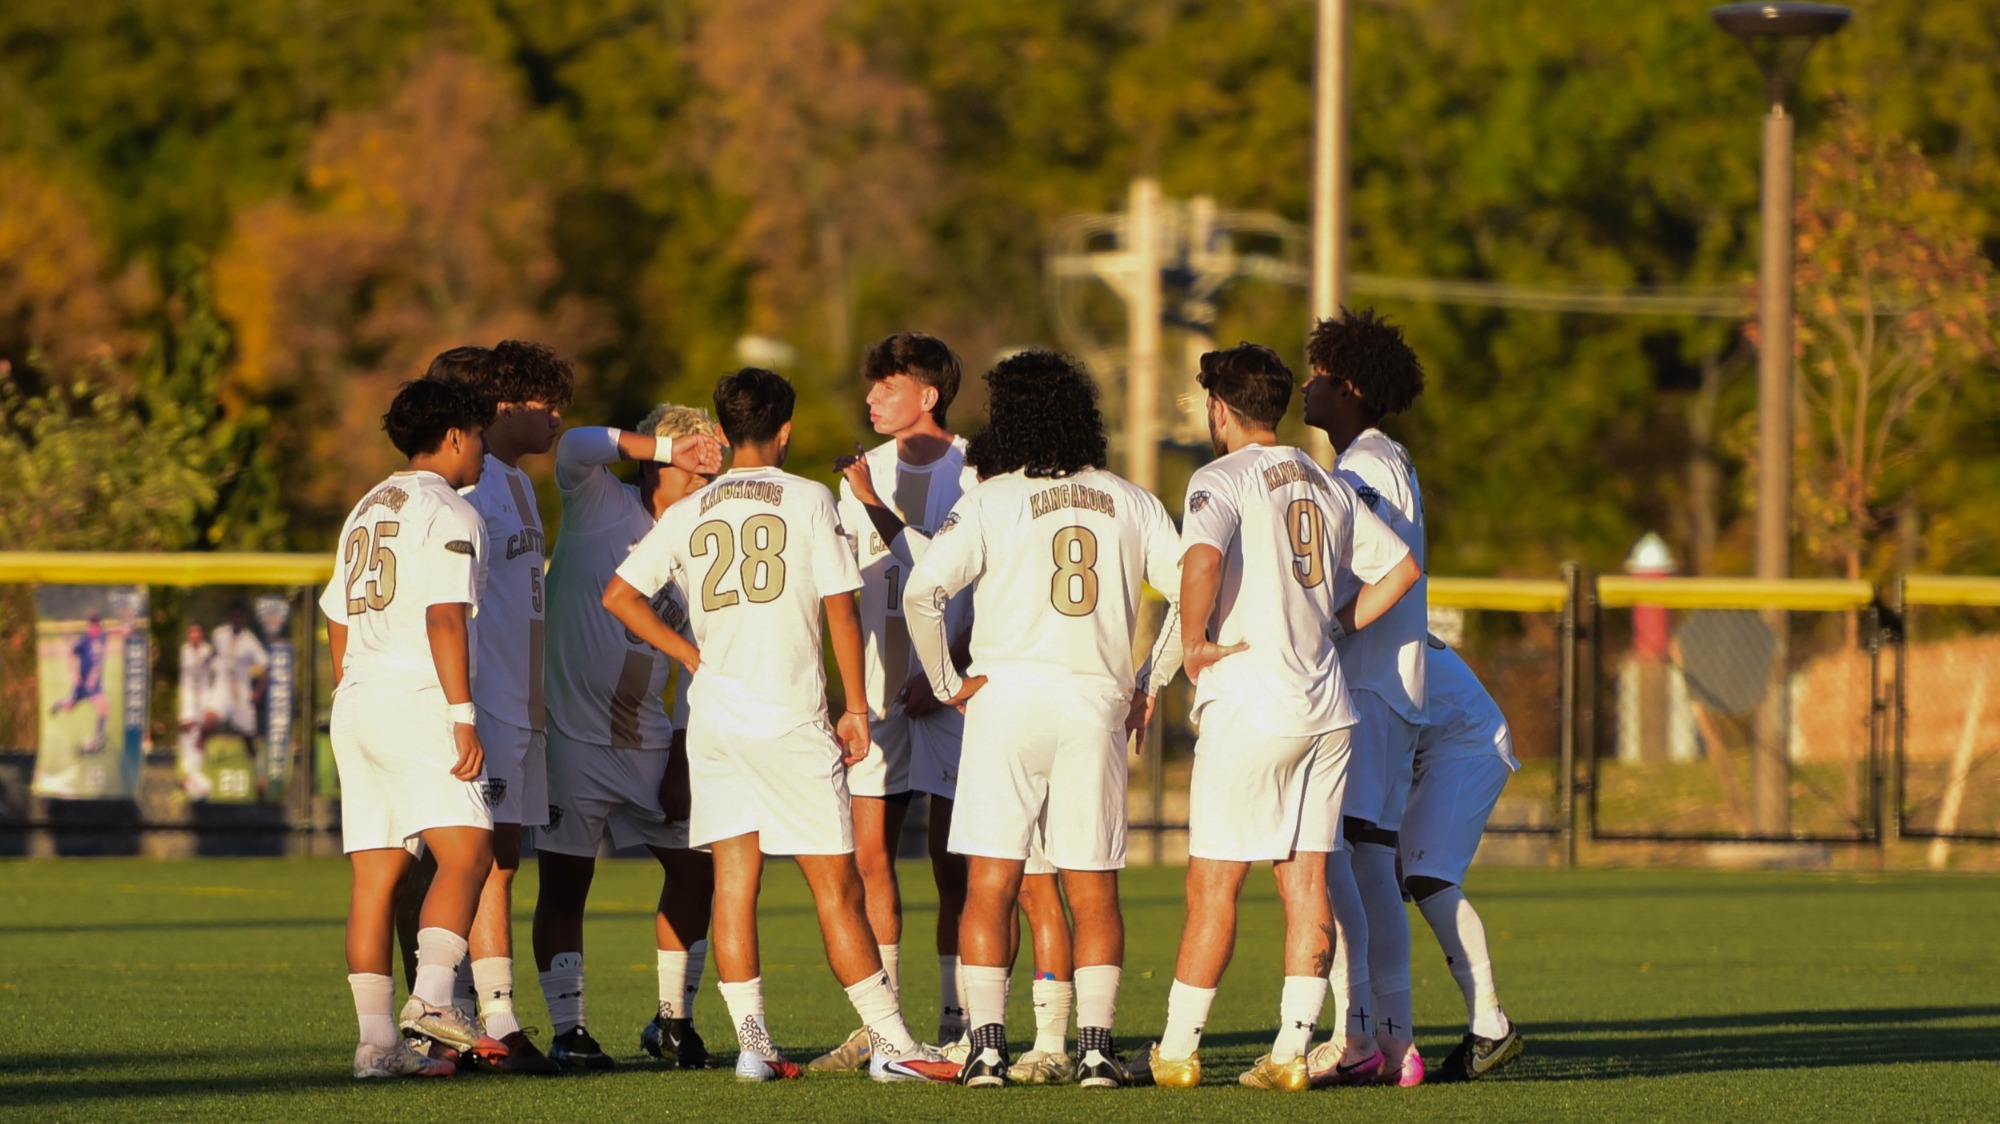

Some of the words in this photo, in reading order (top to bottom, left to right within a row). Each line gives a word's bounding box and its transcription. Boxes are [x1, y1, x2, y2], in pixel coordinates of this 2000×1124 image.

[1030, 483, 1116, 520] KANGAROOS
[1263, 459, 1331, 497] KANGA
[506, 527, 546, 560] CANTO
[689, 513, 787, 613] 28
[1287, 498, 1325, 589] 9
[345, 521, 400, 616] 25
[531, 566, 543, 613] 5
[884, 564, 903, 611] 1
[1051, 525, 1099, 617] 8
